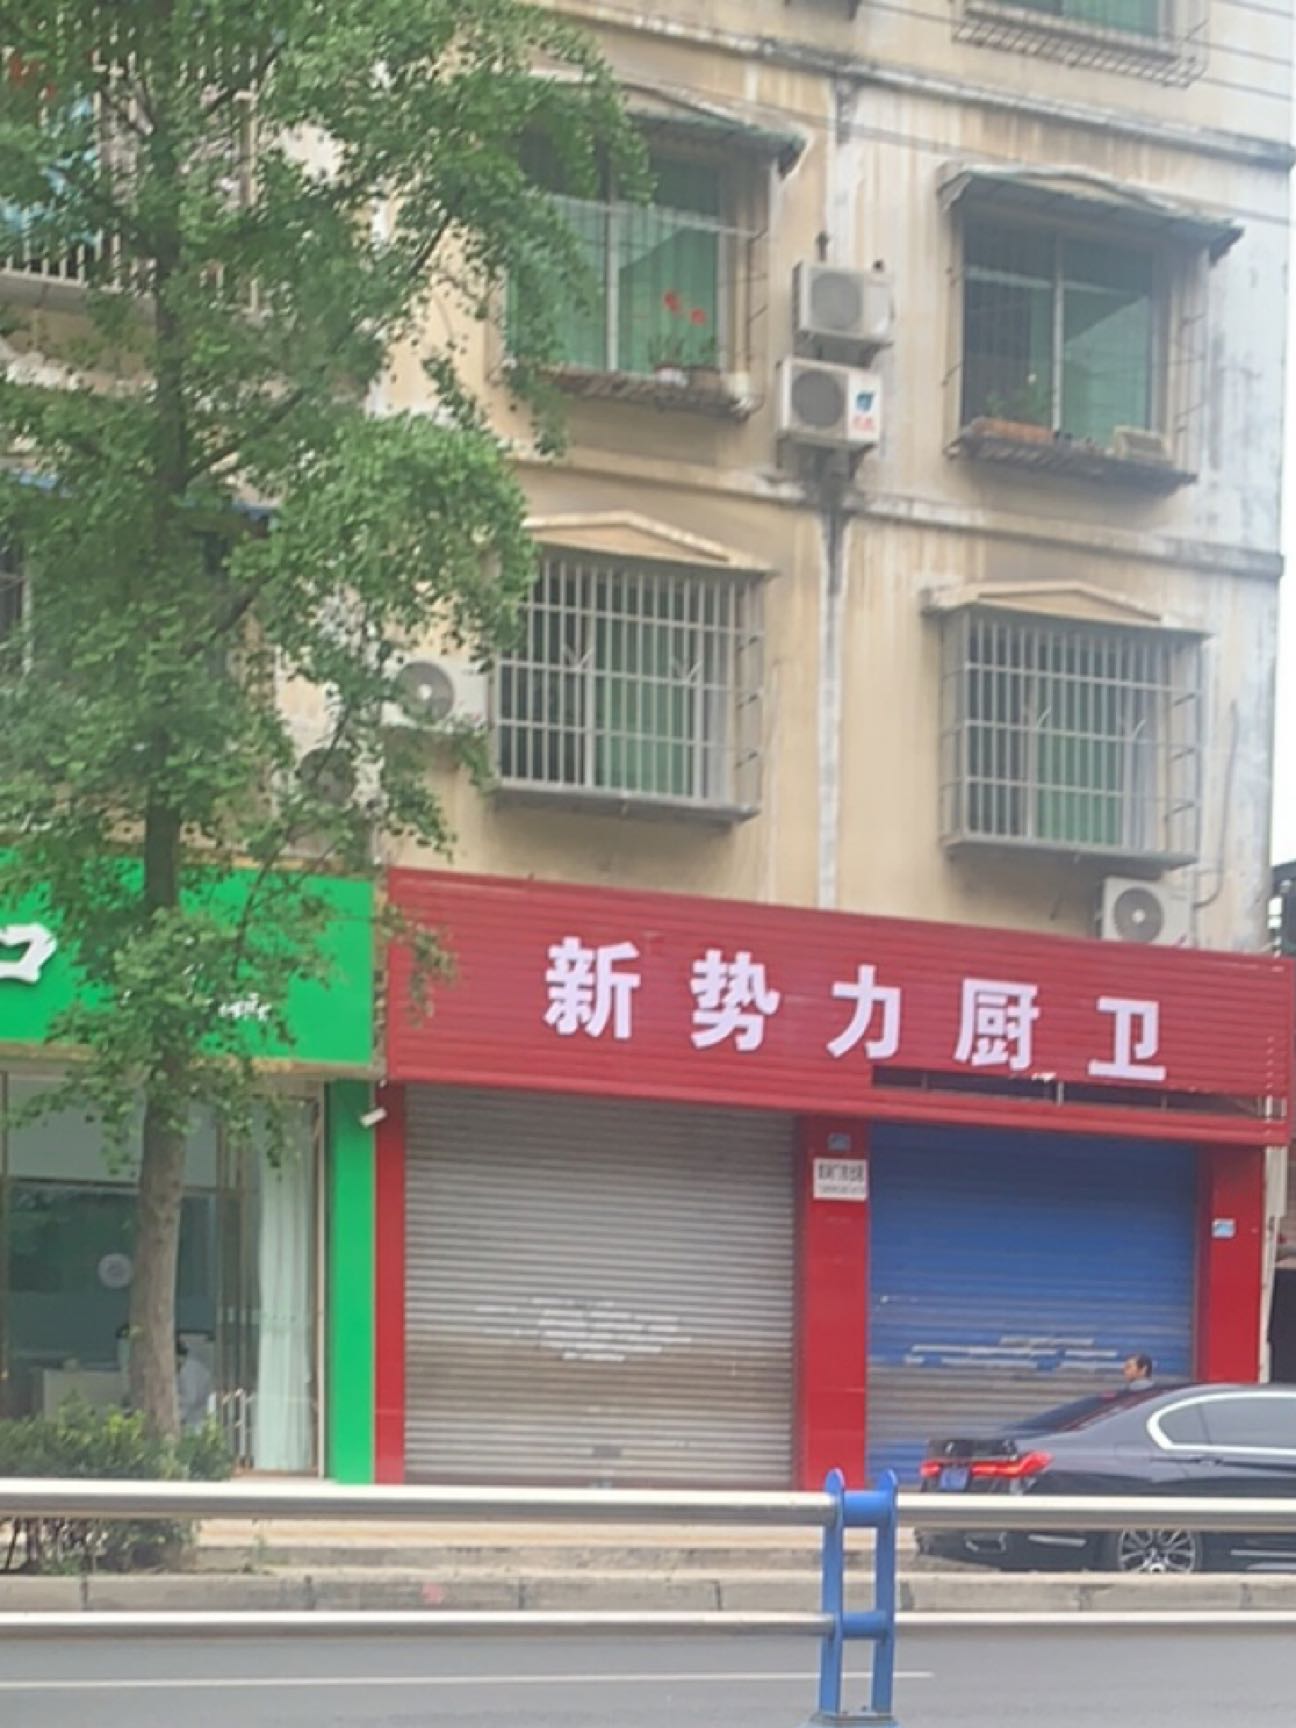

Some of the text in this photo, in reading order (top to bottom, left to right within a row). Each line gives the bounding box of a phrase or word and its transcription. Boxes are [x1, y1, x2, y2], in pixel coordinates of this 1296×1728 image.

[545, 936, 1167, 1082] 新势力厨卫
